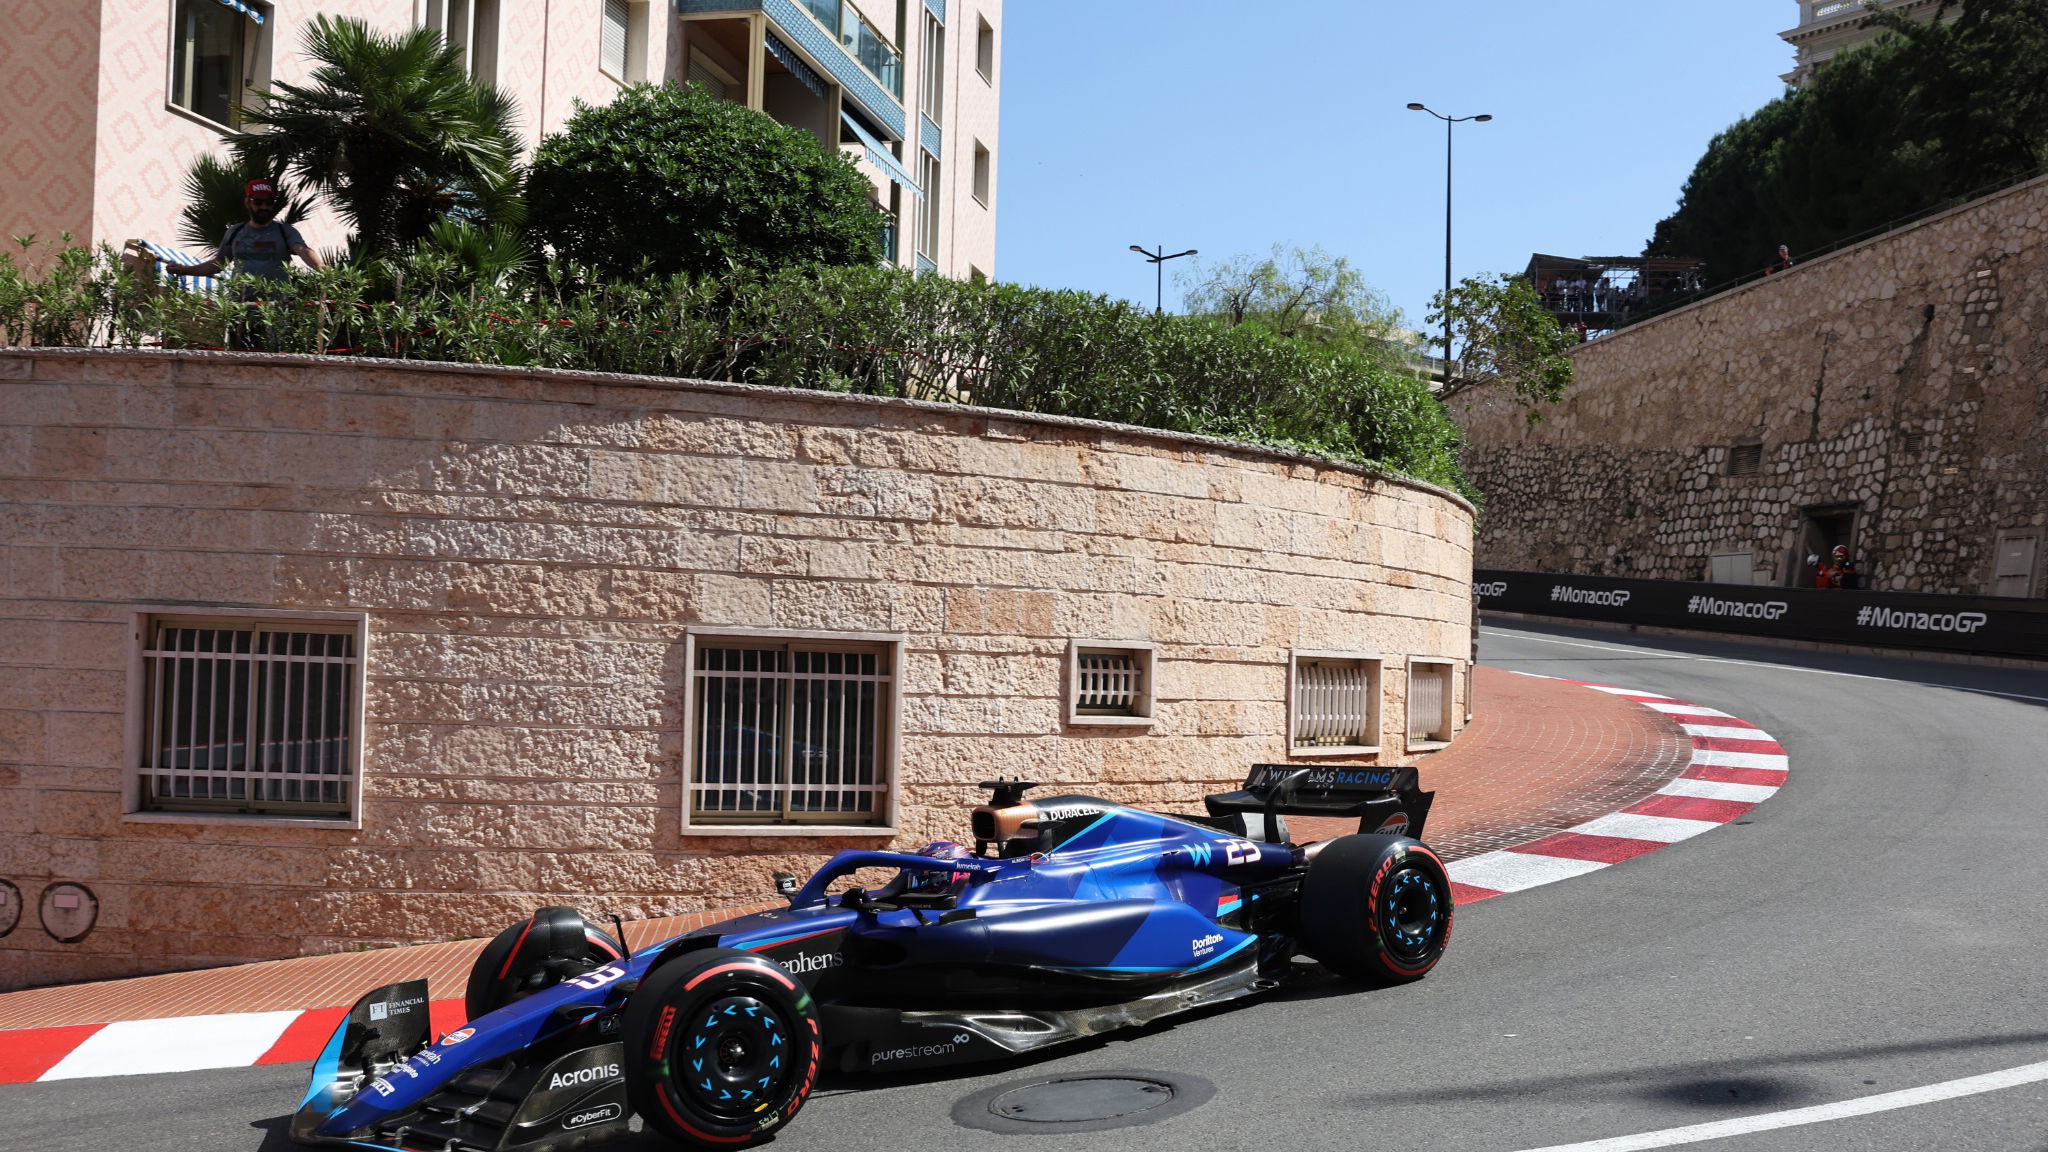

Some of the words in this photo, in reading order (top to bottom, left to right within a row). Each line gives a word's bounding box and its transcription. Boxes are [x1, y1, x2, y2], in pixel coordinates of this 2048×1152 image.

[1472, 581, 1507, 596] acoGP
[1551, 585, 1630, 606] #MonacoGP
[1688, 595, 1788, 620] #MonacoGP
[1857, 606, 1987, 633] #MonacoGP
[1336, 772, 1391, 784] RACING
[1050, 807, 1100, 821] DURACELL
[1214, 839, 1262, 866] 23
[1192, 934, 1222, 950] Dorilton
[780, 951, 844, 974] ephens
[388, 997, 425, 1008] FINANCIAL
[389, 1006, 411, 1016] TIMES
[872, 1043, 955, 1066] purestream
[549, 1063, 620, 1090] Acronis
[787, 1040, 819, 1116] ZERO
[570, 1109, 612, 1124] #CyberFit
